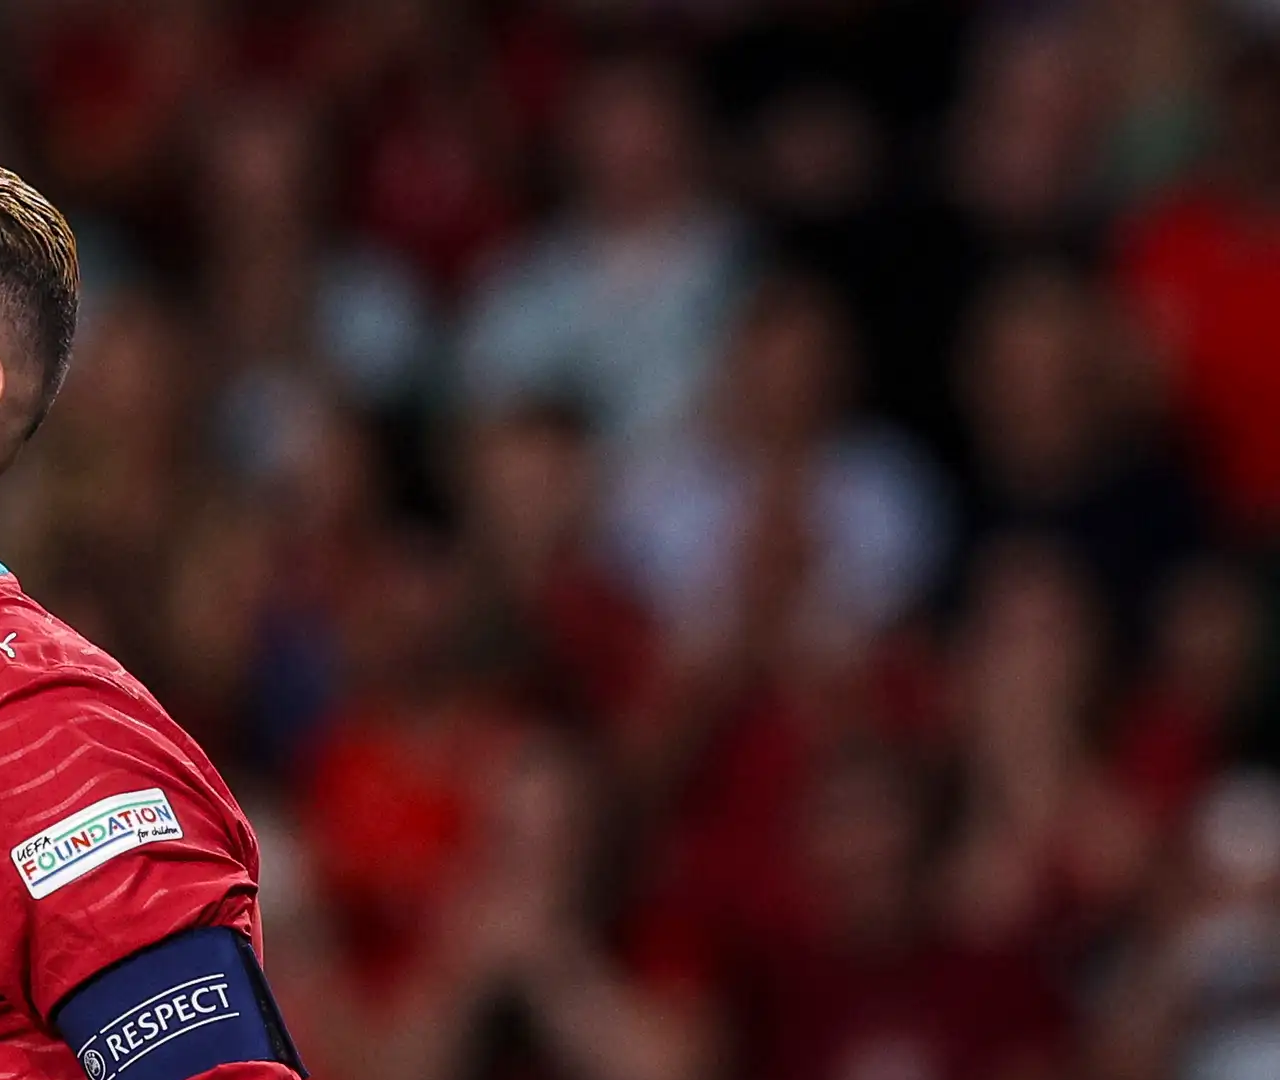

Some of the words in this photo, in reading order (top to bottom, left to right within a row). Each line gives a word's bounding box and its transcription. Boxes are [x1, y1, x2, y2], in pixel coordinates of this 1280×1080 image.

[16, 834, 53, 862] UEFA
[136, 828, 149, 843] for
[151, 826, 179, 837] children
[105, 983, 229, 1061] RESPECT
